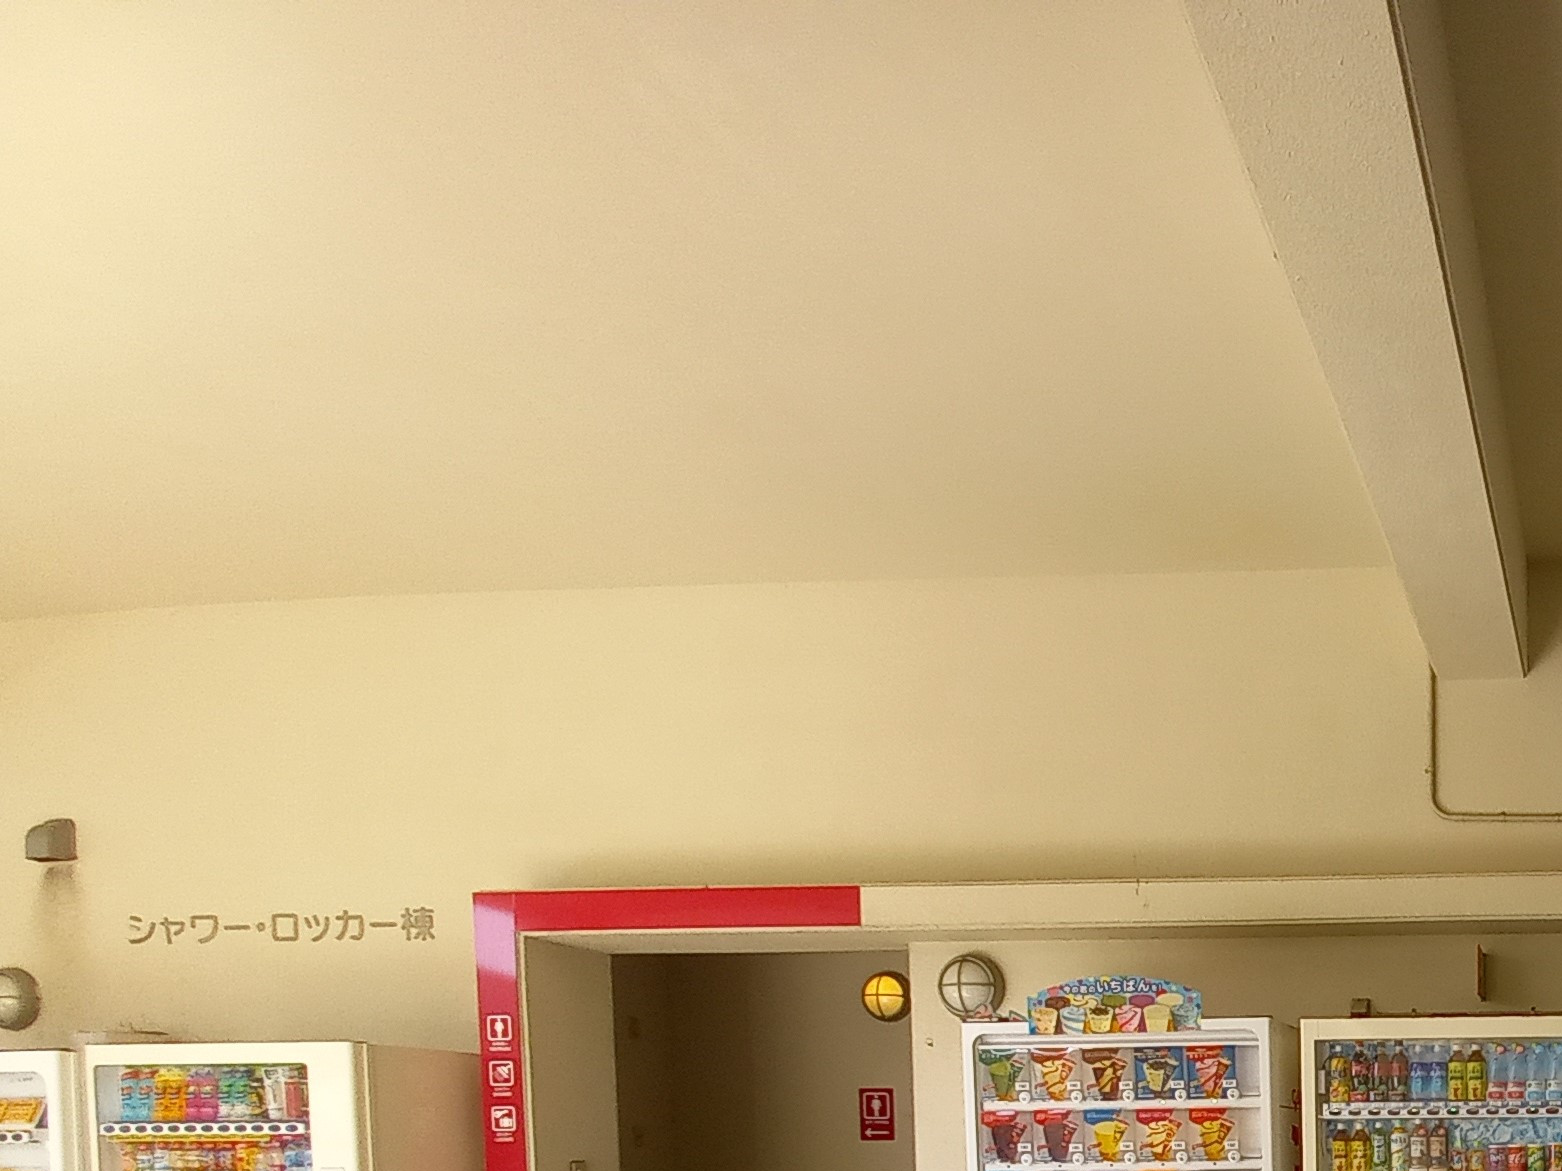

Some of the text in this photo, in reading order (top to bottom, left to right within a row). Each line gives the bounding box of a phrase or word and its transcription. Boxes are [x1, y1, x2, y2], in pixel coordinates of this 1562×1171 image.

[128, 907, 436, 945] シャワー・ロッカー棟
